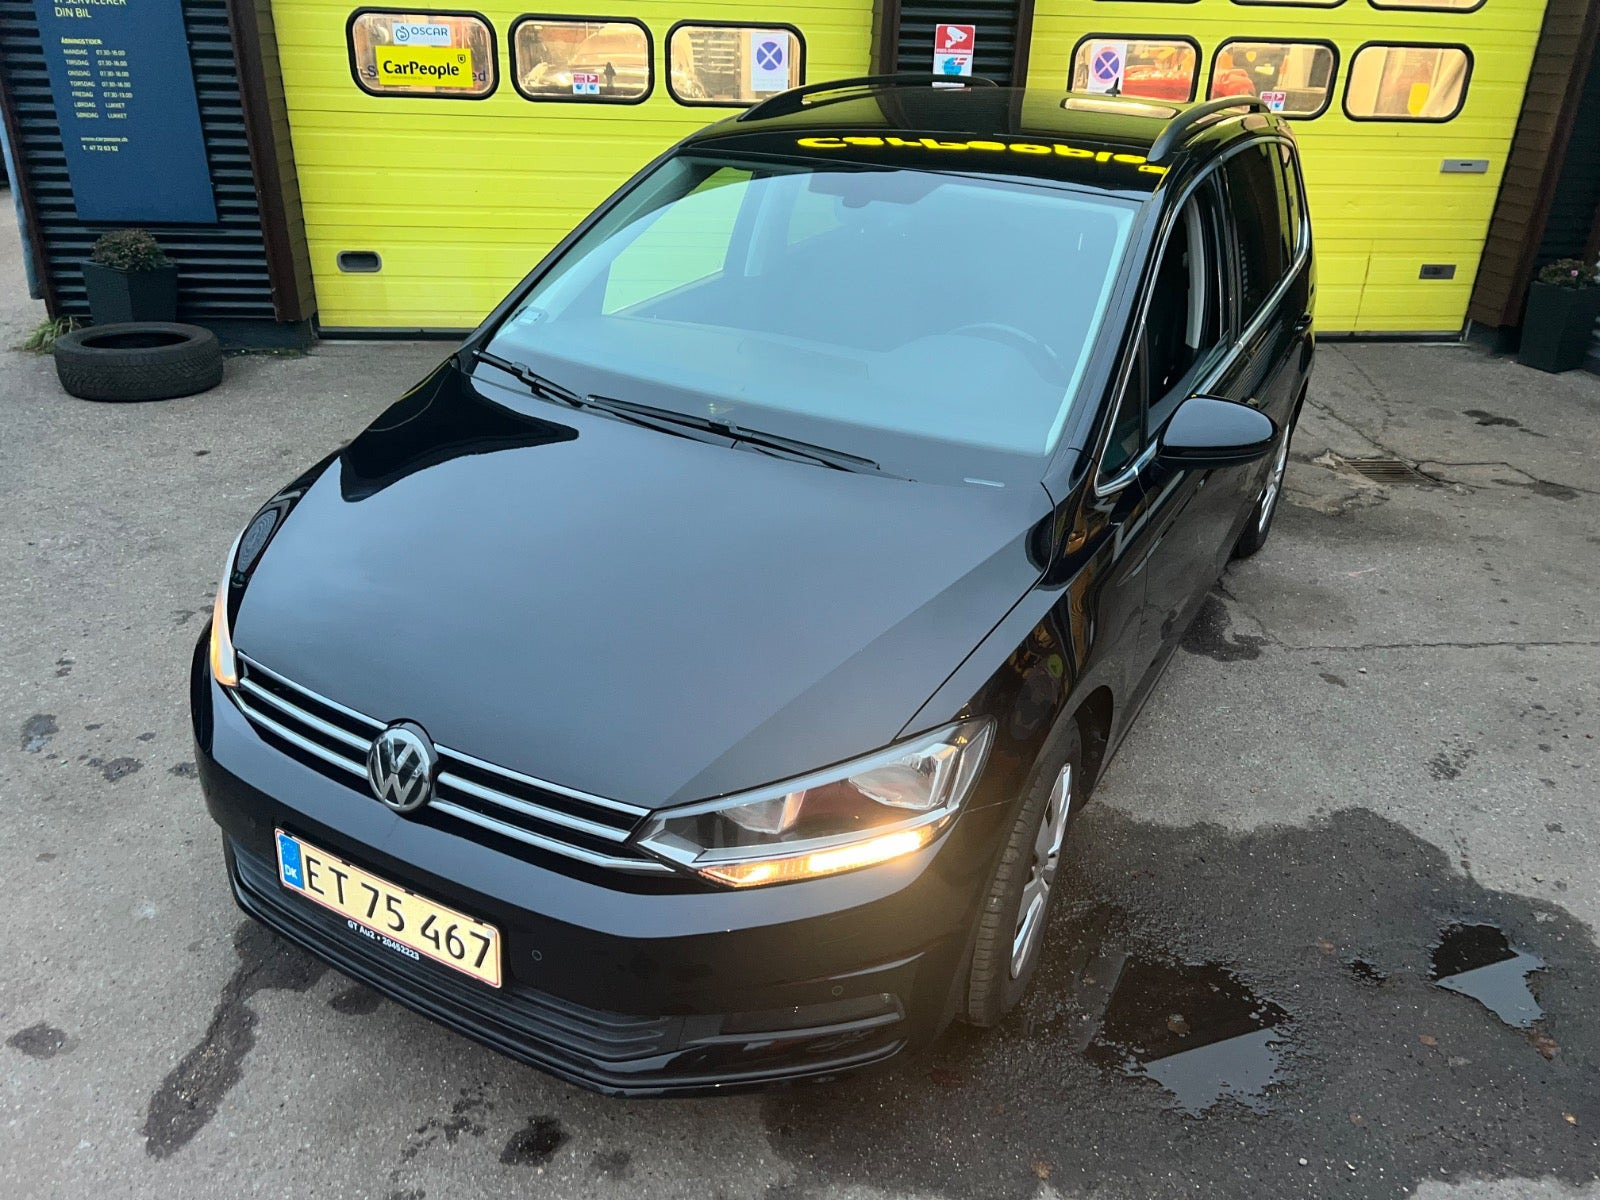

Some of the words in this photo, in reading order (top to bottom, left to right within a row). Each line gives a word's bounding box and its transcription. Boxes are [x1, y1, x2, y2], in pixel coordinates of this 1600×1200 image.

[54, 6, 74, 17] DIN
[75, 7, 92, 18] BIL
[410, 26, 448, 37] OSCAR
[383, 60, 460, 80] CarPeople
[284, 863, 298, 880] DK
[305, 854, 349, 905] ET
[361, 882, 405, 933] 75
[420, 914, 491, 969] 467
[347, 920, 358, 931] GT
